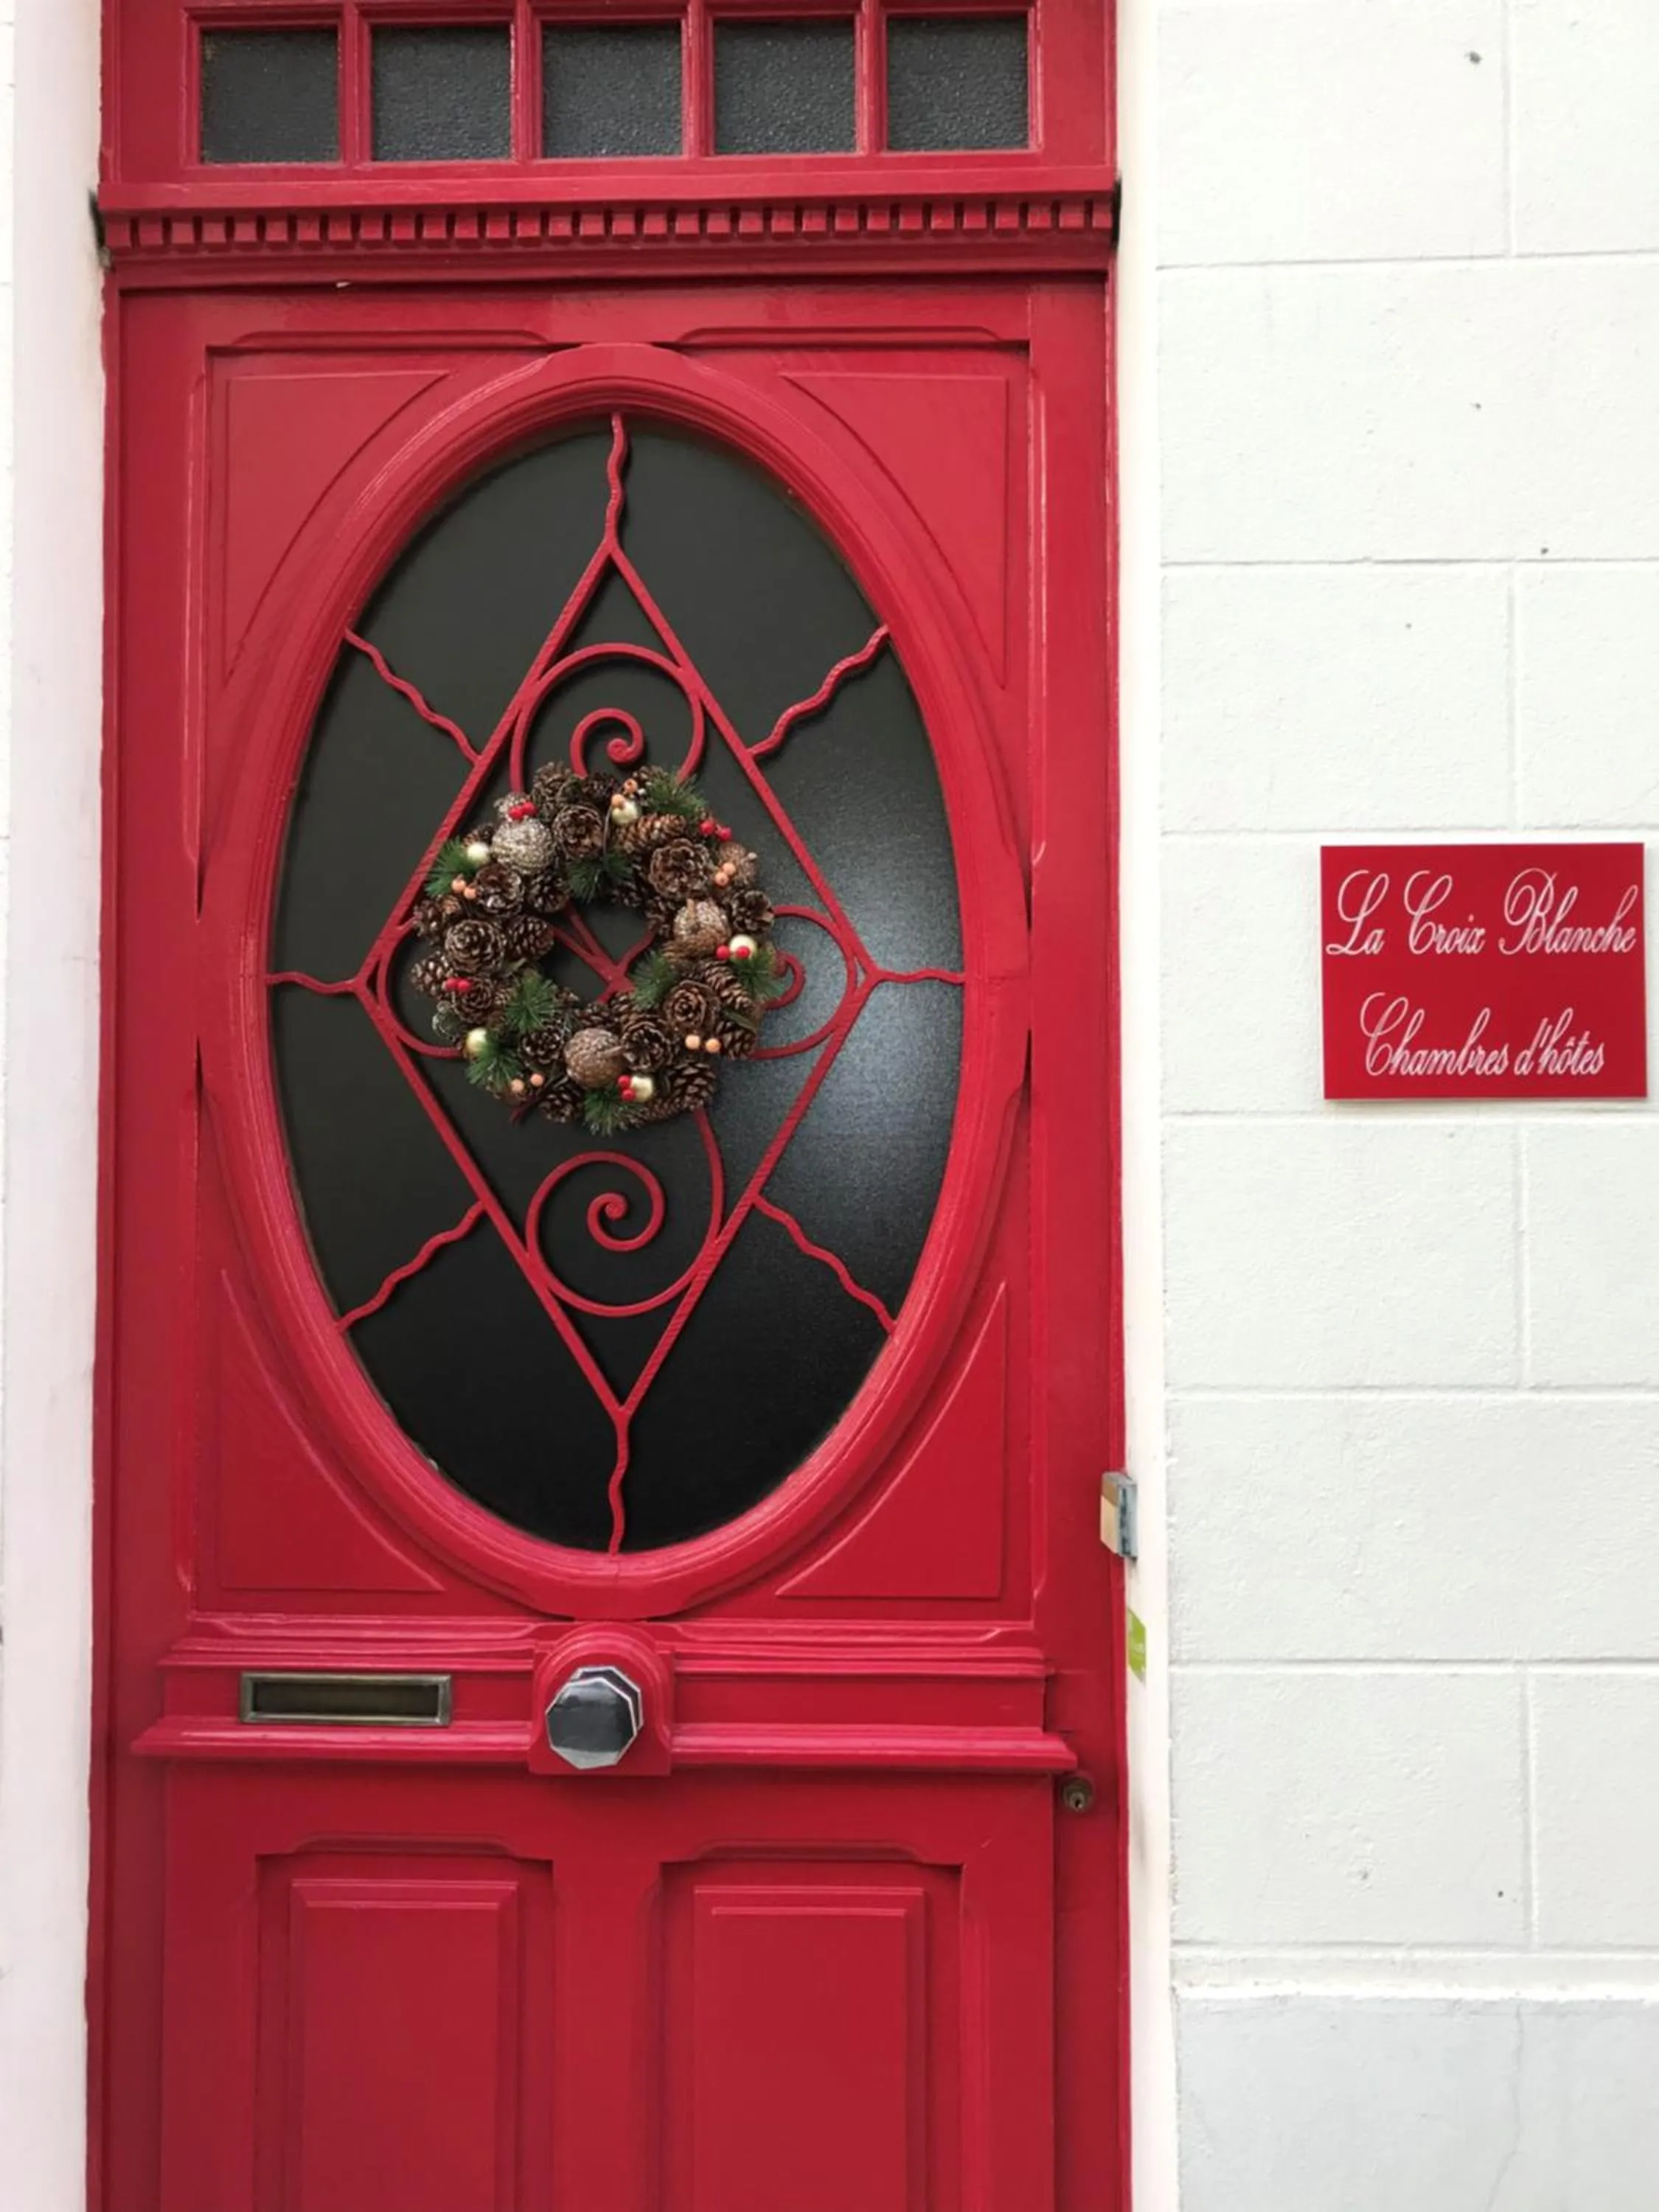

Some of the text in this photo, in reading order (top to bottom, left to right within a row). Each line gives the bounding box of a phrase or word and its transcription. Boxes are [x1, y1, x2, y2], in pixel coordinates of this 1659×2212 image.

[1326, 868, 1638, 956] La Croix Blanche
[1360, 992, 1604, 1076] Chambres d'hôtes
